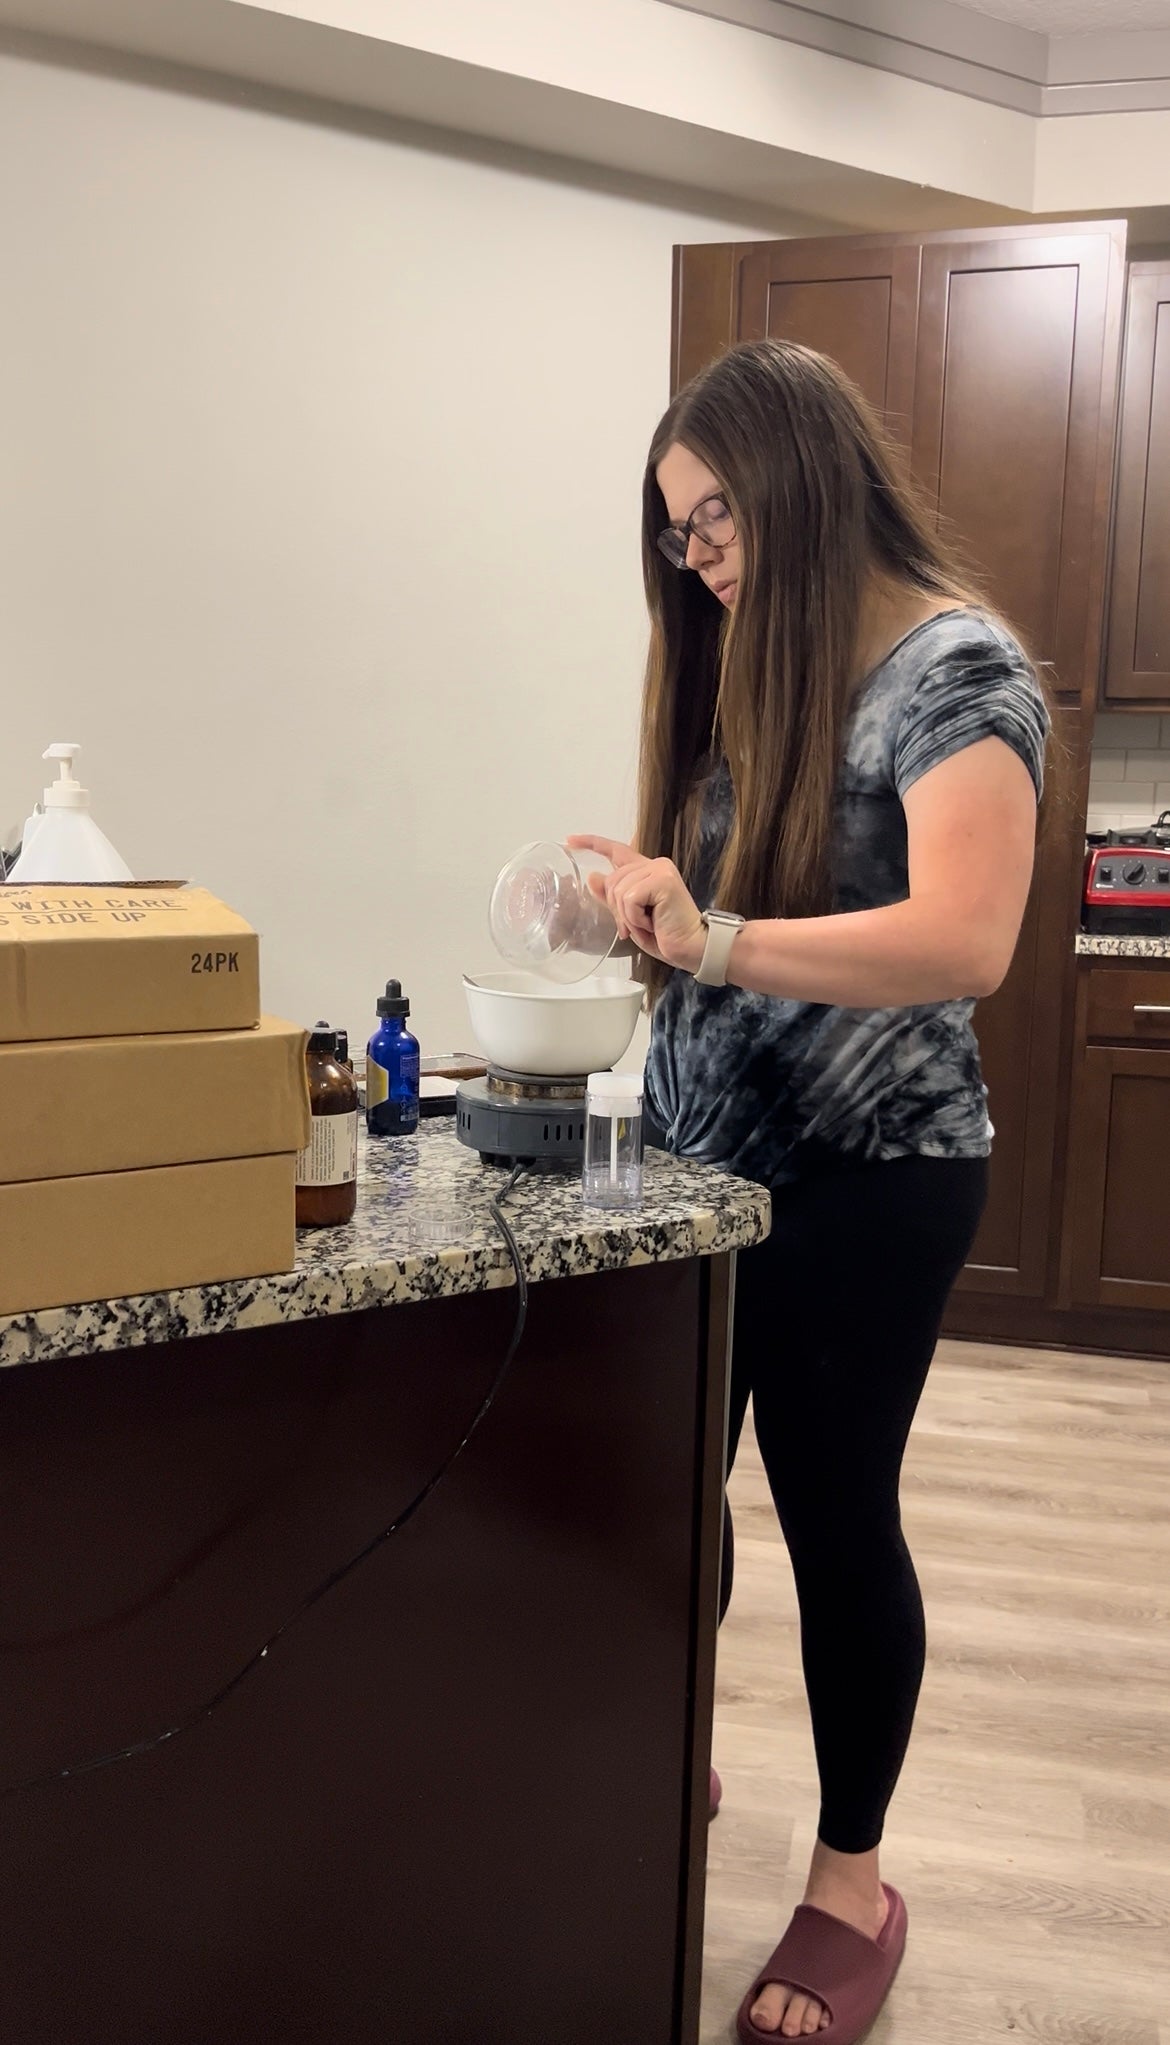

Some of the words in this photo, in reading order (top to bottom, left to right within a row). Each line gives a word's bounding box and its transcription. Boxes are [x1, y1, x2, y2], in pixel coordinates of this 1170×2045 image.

[12, 900, 94, 911] WITH
[106, 899, 183, 909] CARE
[21, 912, 99, 925] SIDE
[111, 912, 147, 923] UP
[190, 951, 240, 974] 24PK
